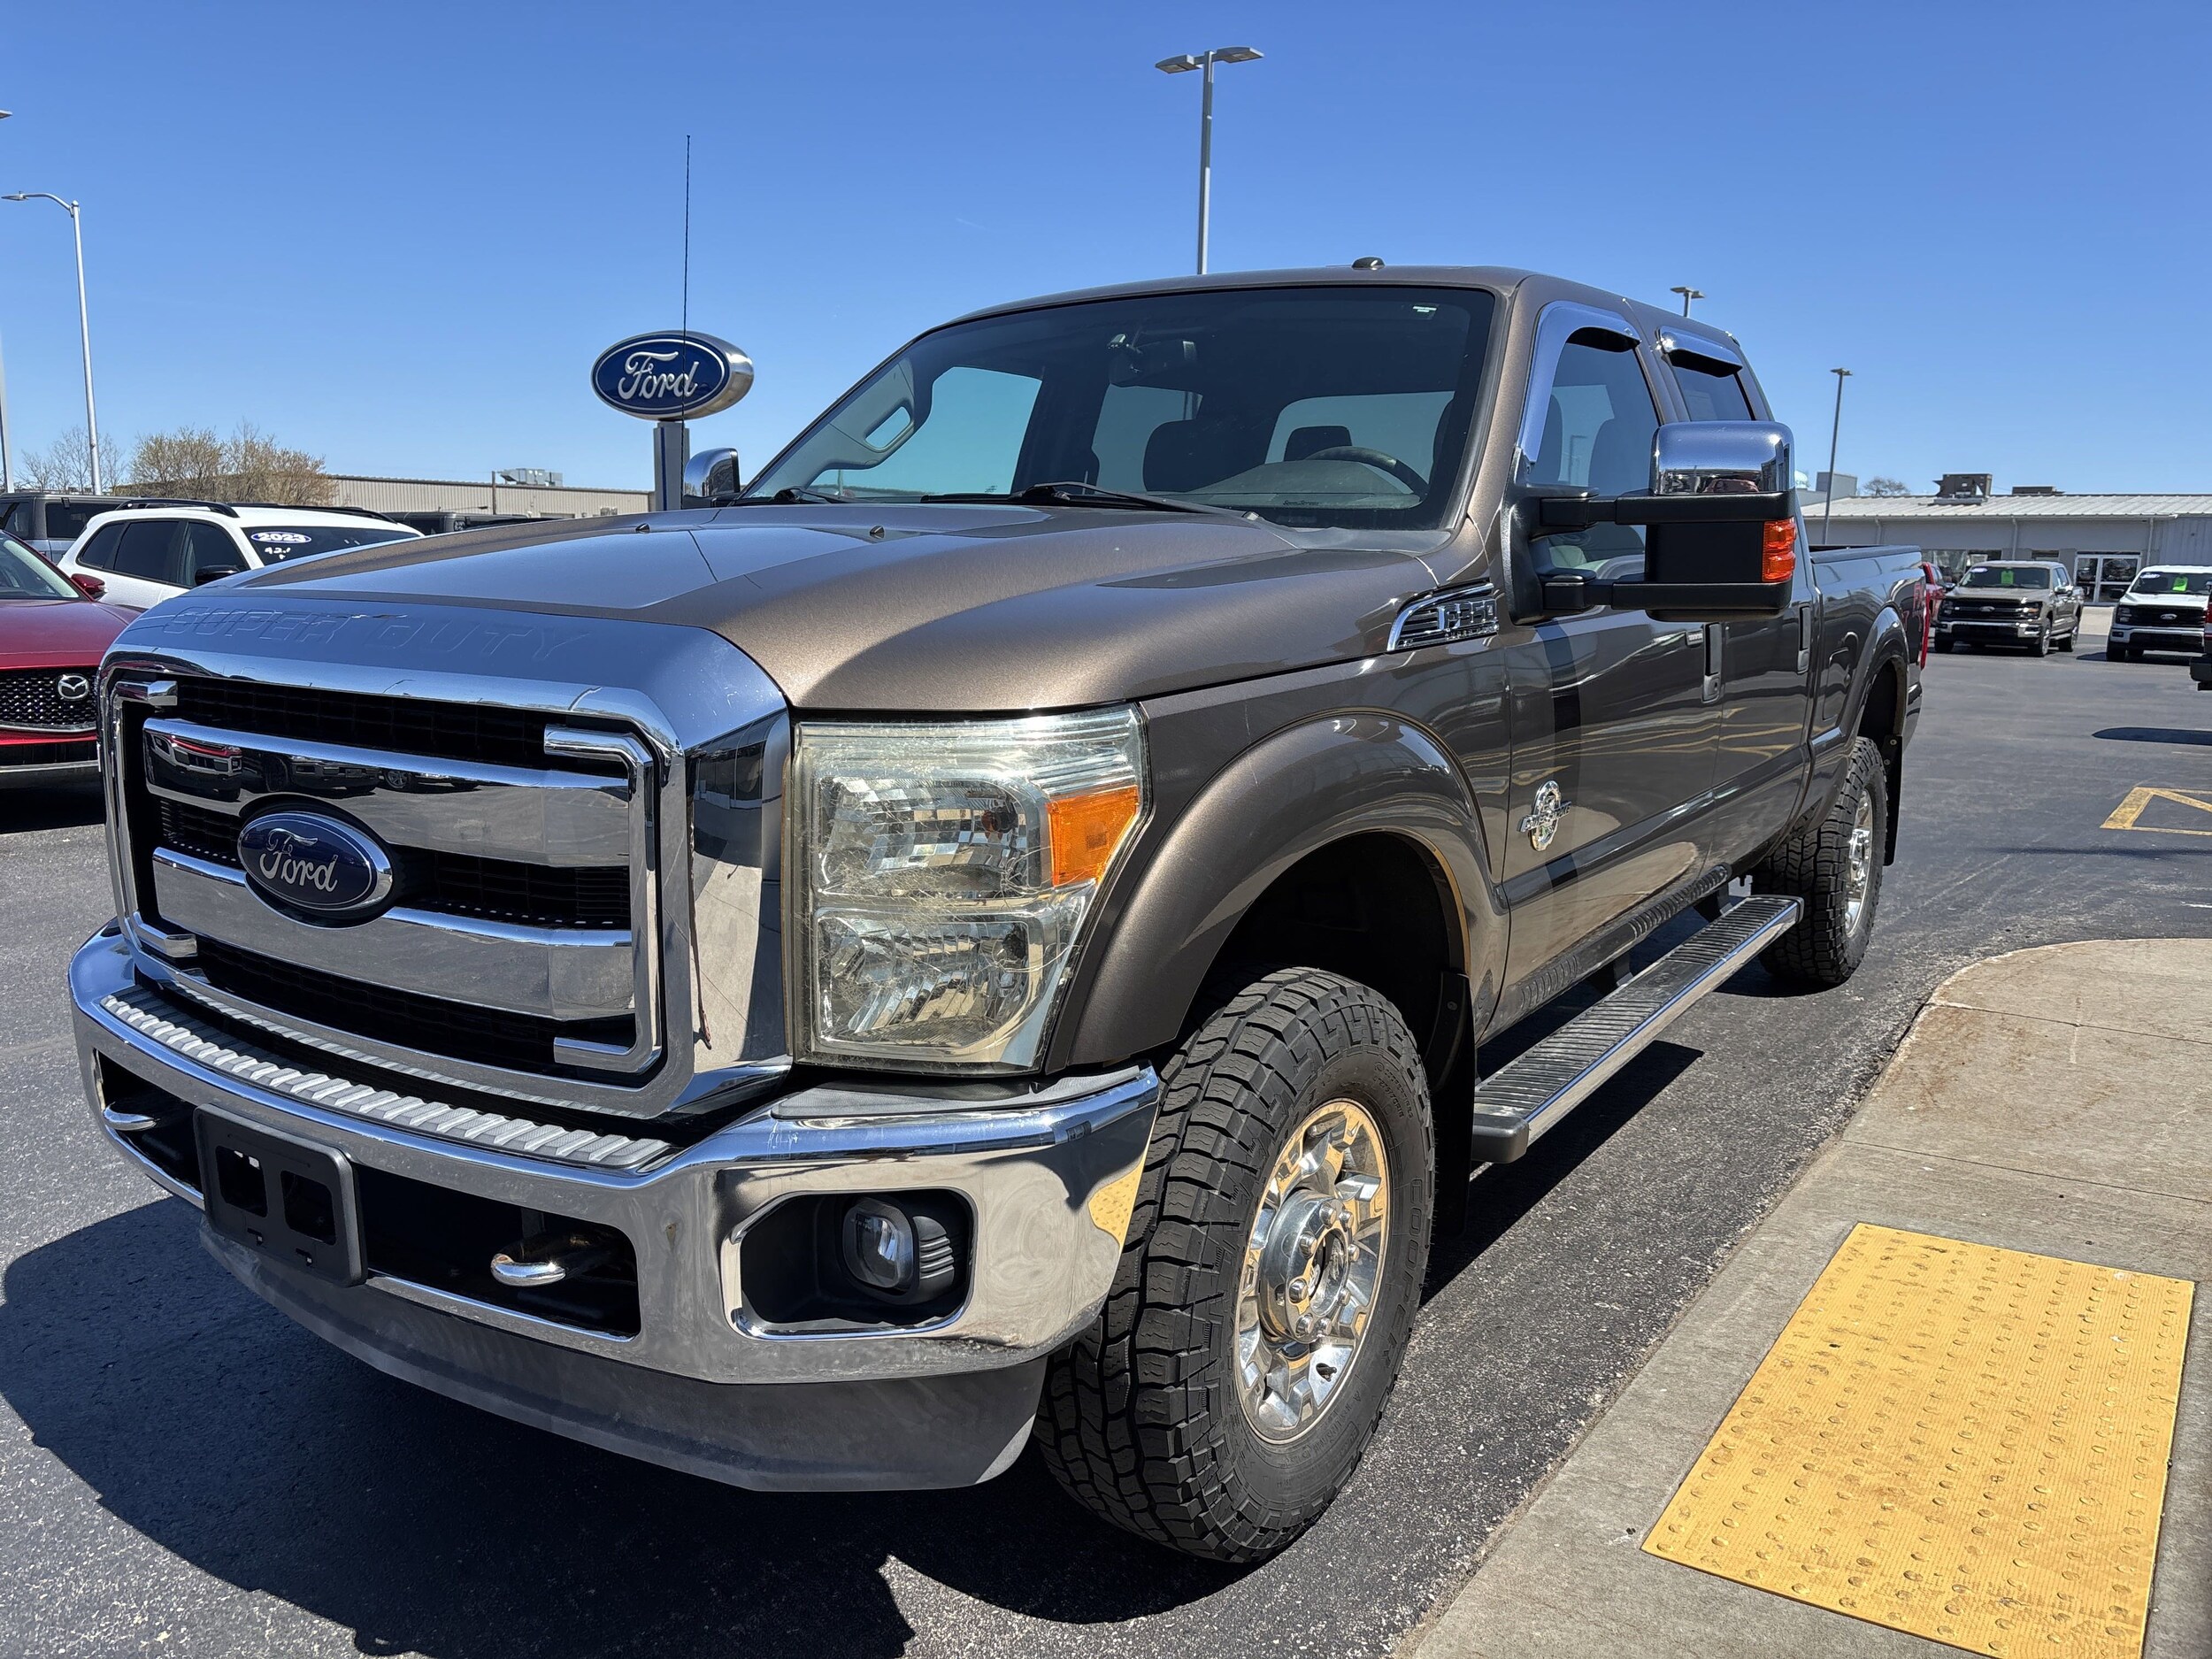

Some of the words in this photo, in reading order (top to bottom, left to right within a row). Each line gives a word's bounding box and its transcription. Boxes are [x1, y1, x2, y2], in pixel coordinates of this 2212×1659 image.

[618, 351, 699, 398] Ford
[257, 533, 306, 542] 2023
[163, 606, 352, 644] SUPER
[363, 618, 591, 660] DUTY
[259, 827, 339, 893] Ford
